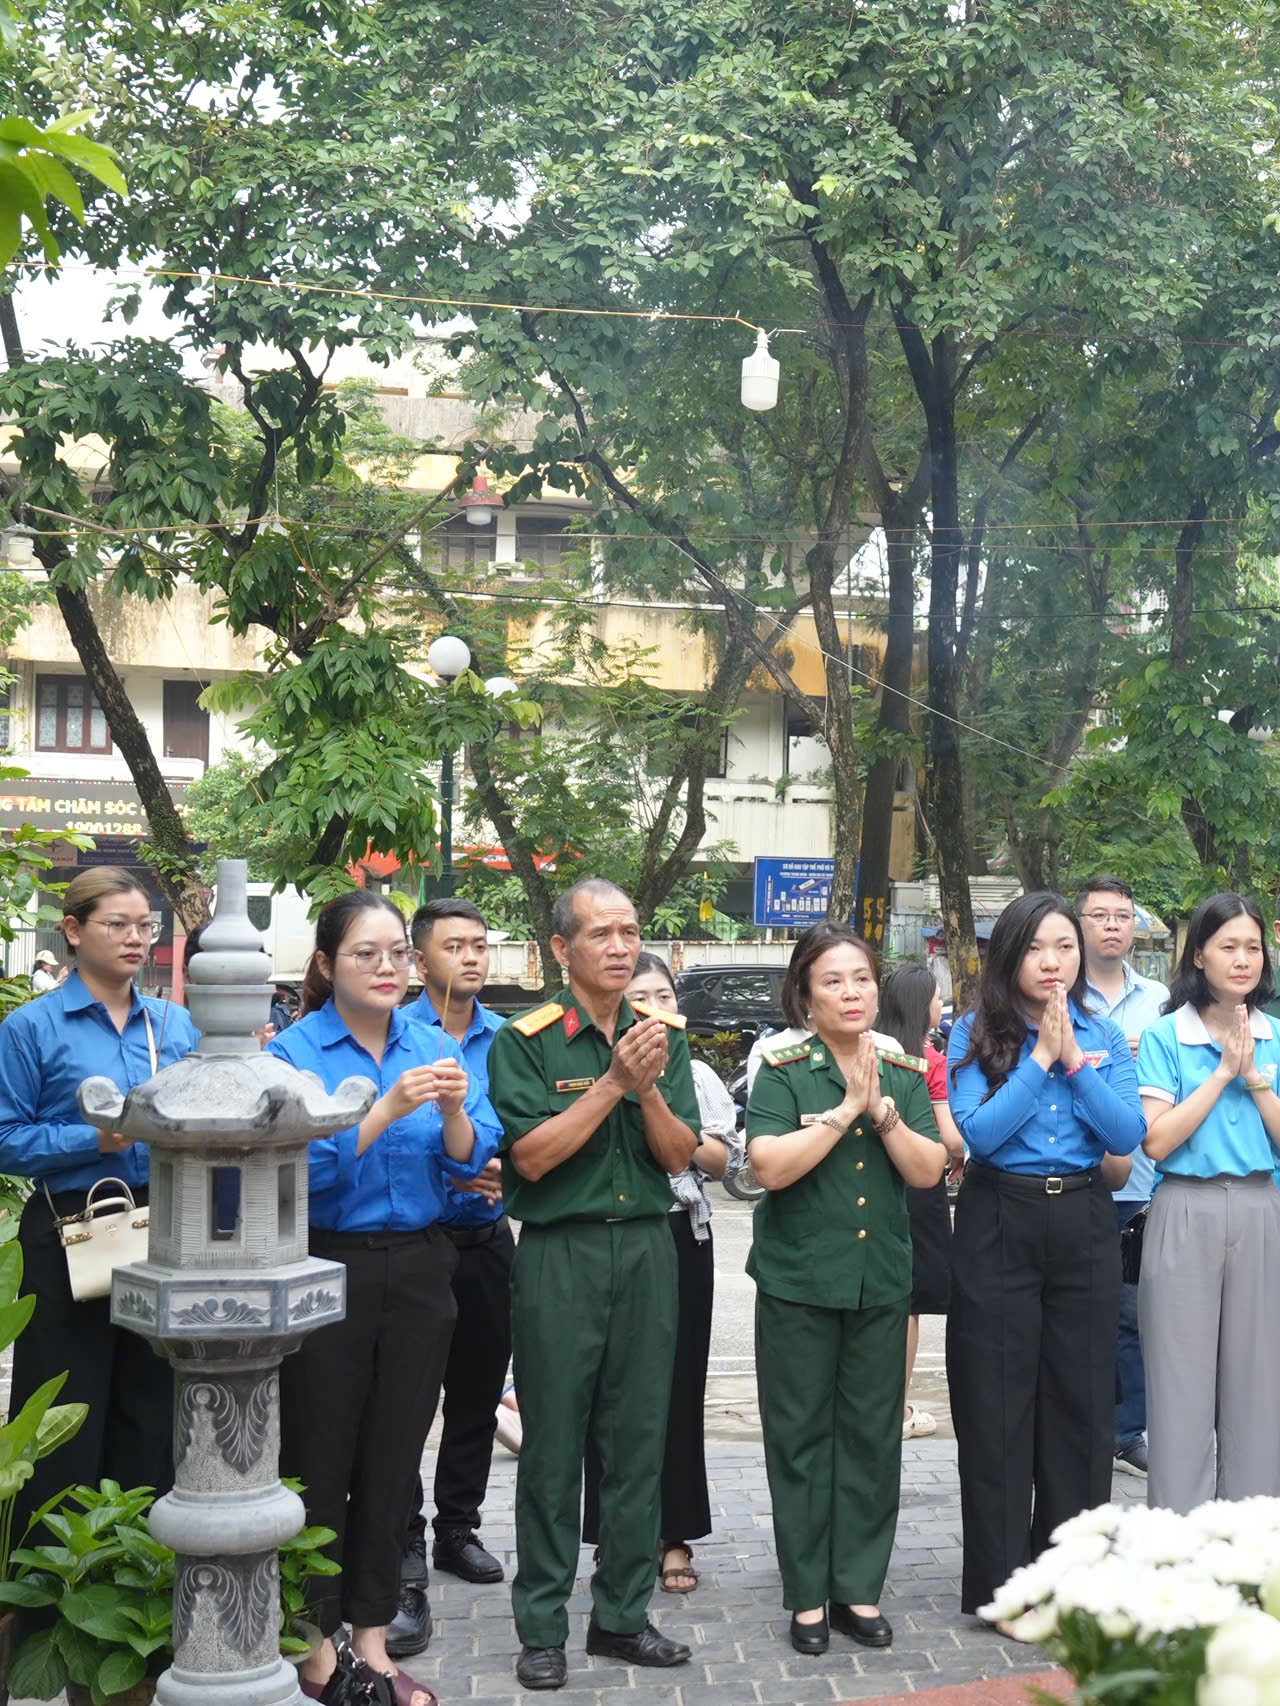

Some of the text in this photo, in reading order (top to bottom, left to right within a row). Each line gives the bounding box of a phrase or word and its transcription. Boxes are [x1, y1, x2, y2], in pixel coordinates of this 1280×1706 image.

[16, 796, 51, 812] TÂM
[54, 798, 101, 814] CHĂM
[104, 799, 138, 816] SÓC
